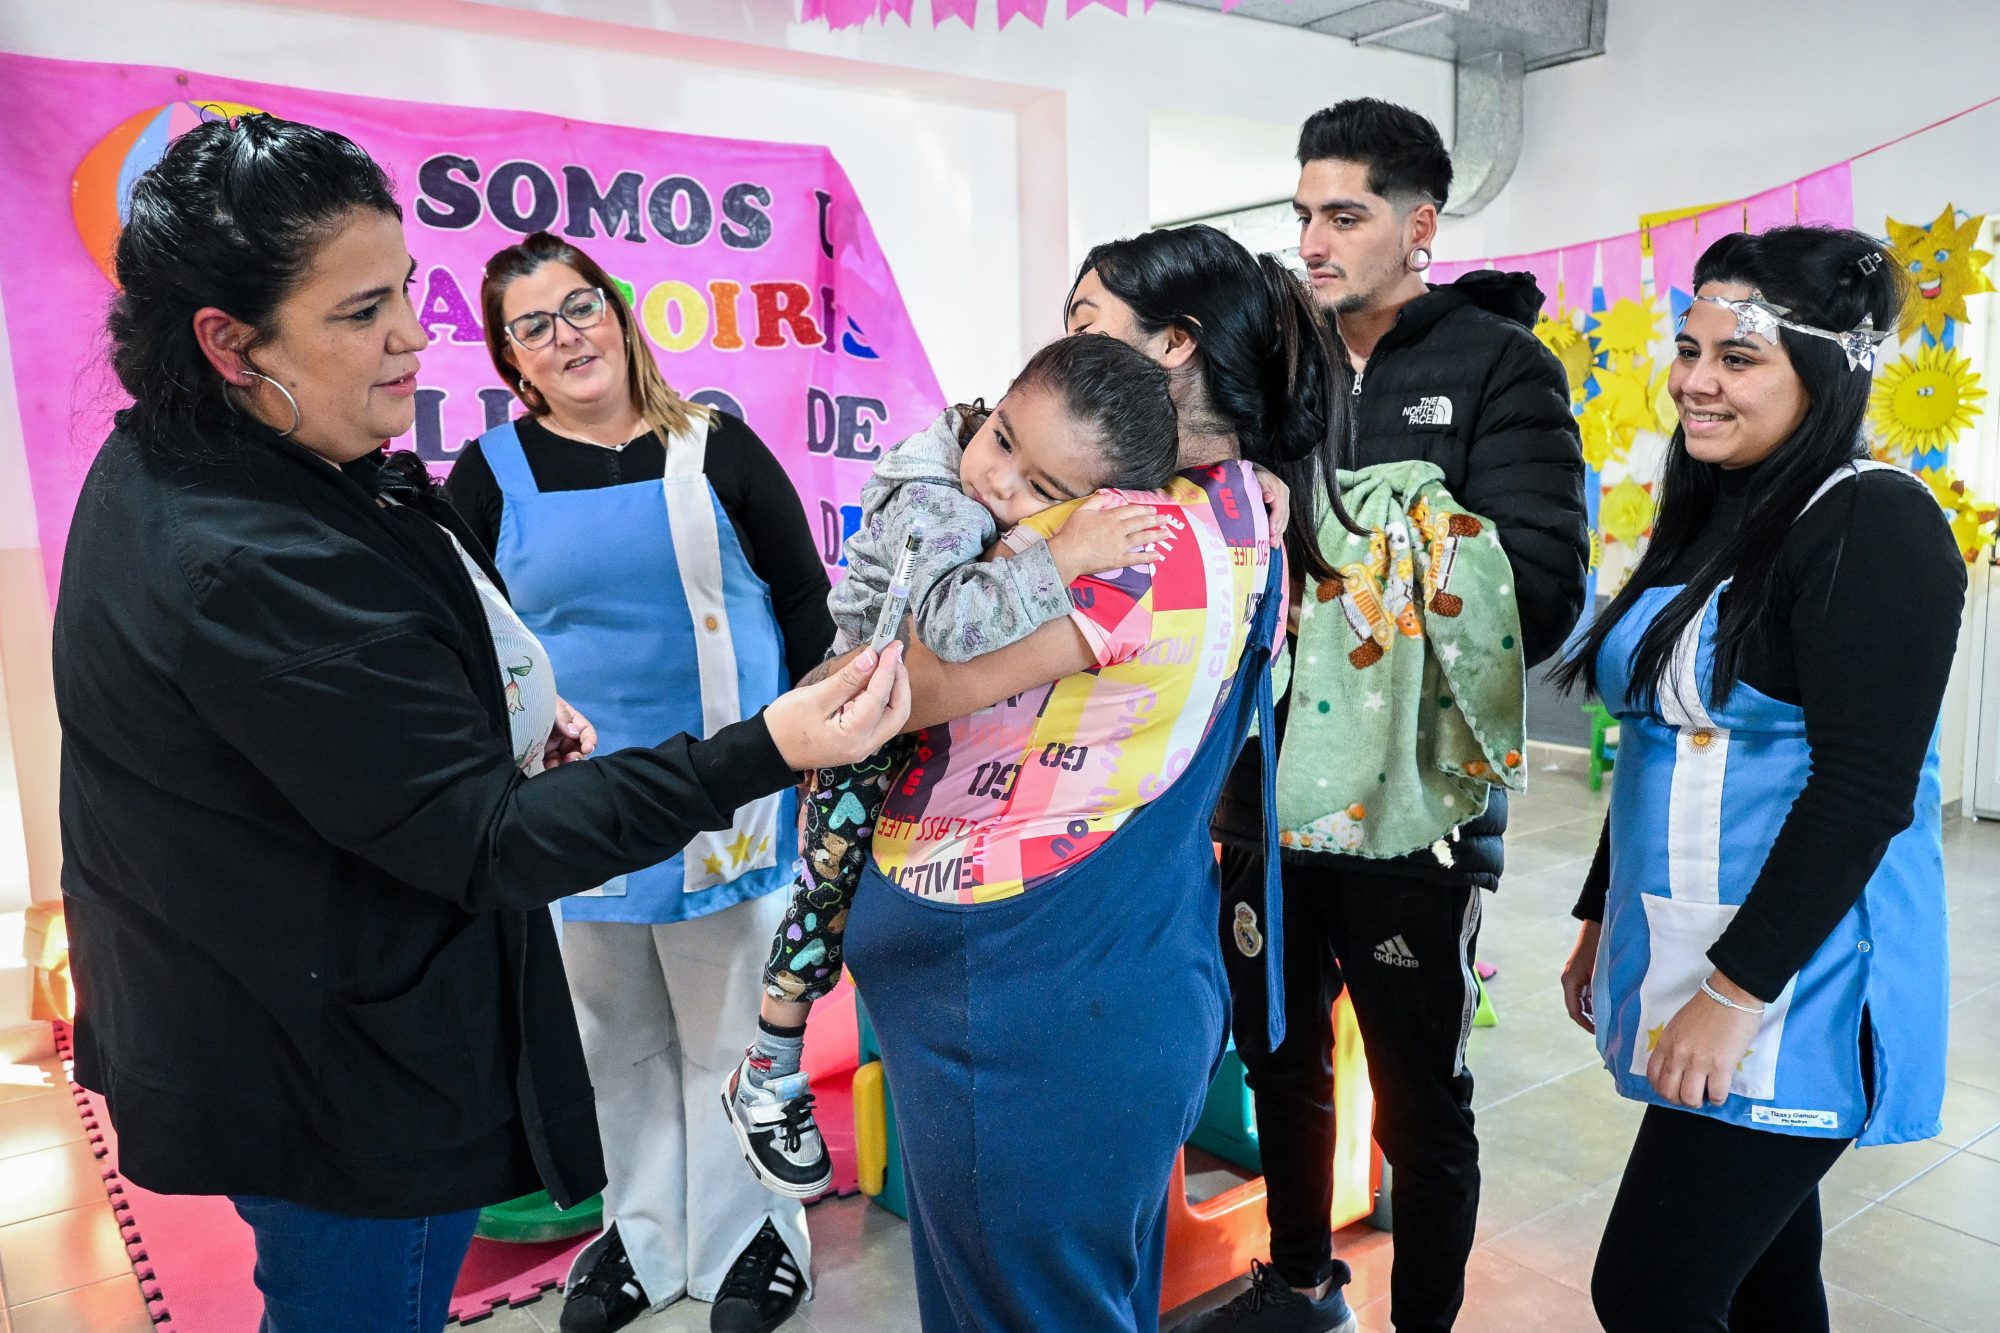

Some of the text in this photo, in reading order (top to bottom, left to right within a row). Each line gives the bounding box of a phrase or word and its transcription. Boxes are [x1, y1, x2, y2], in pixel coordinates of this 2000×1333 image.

[417, 154, 771, 249] SOMOS
[1402, 405, 1436, 417] NORTH
[1420, 396, 1439, 407] THE
[807, 387, 888, 461] DE
[1408, 414, 1433, 425] FACE
[1039, 742, 1089, 772] GO
[967, 761, 1024, 801] GO
[1374, 950, 1420, 969] adidas
